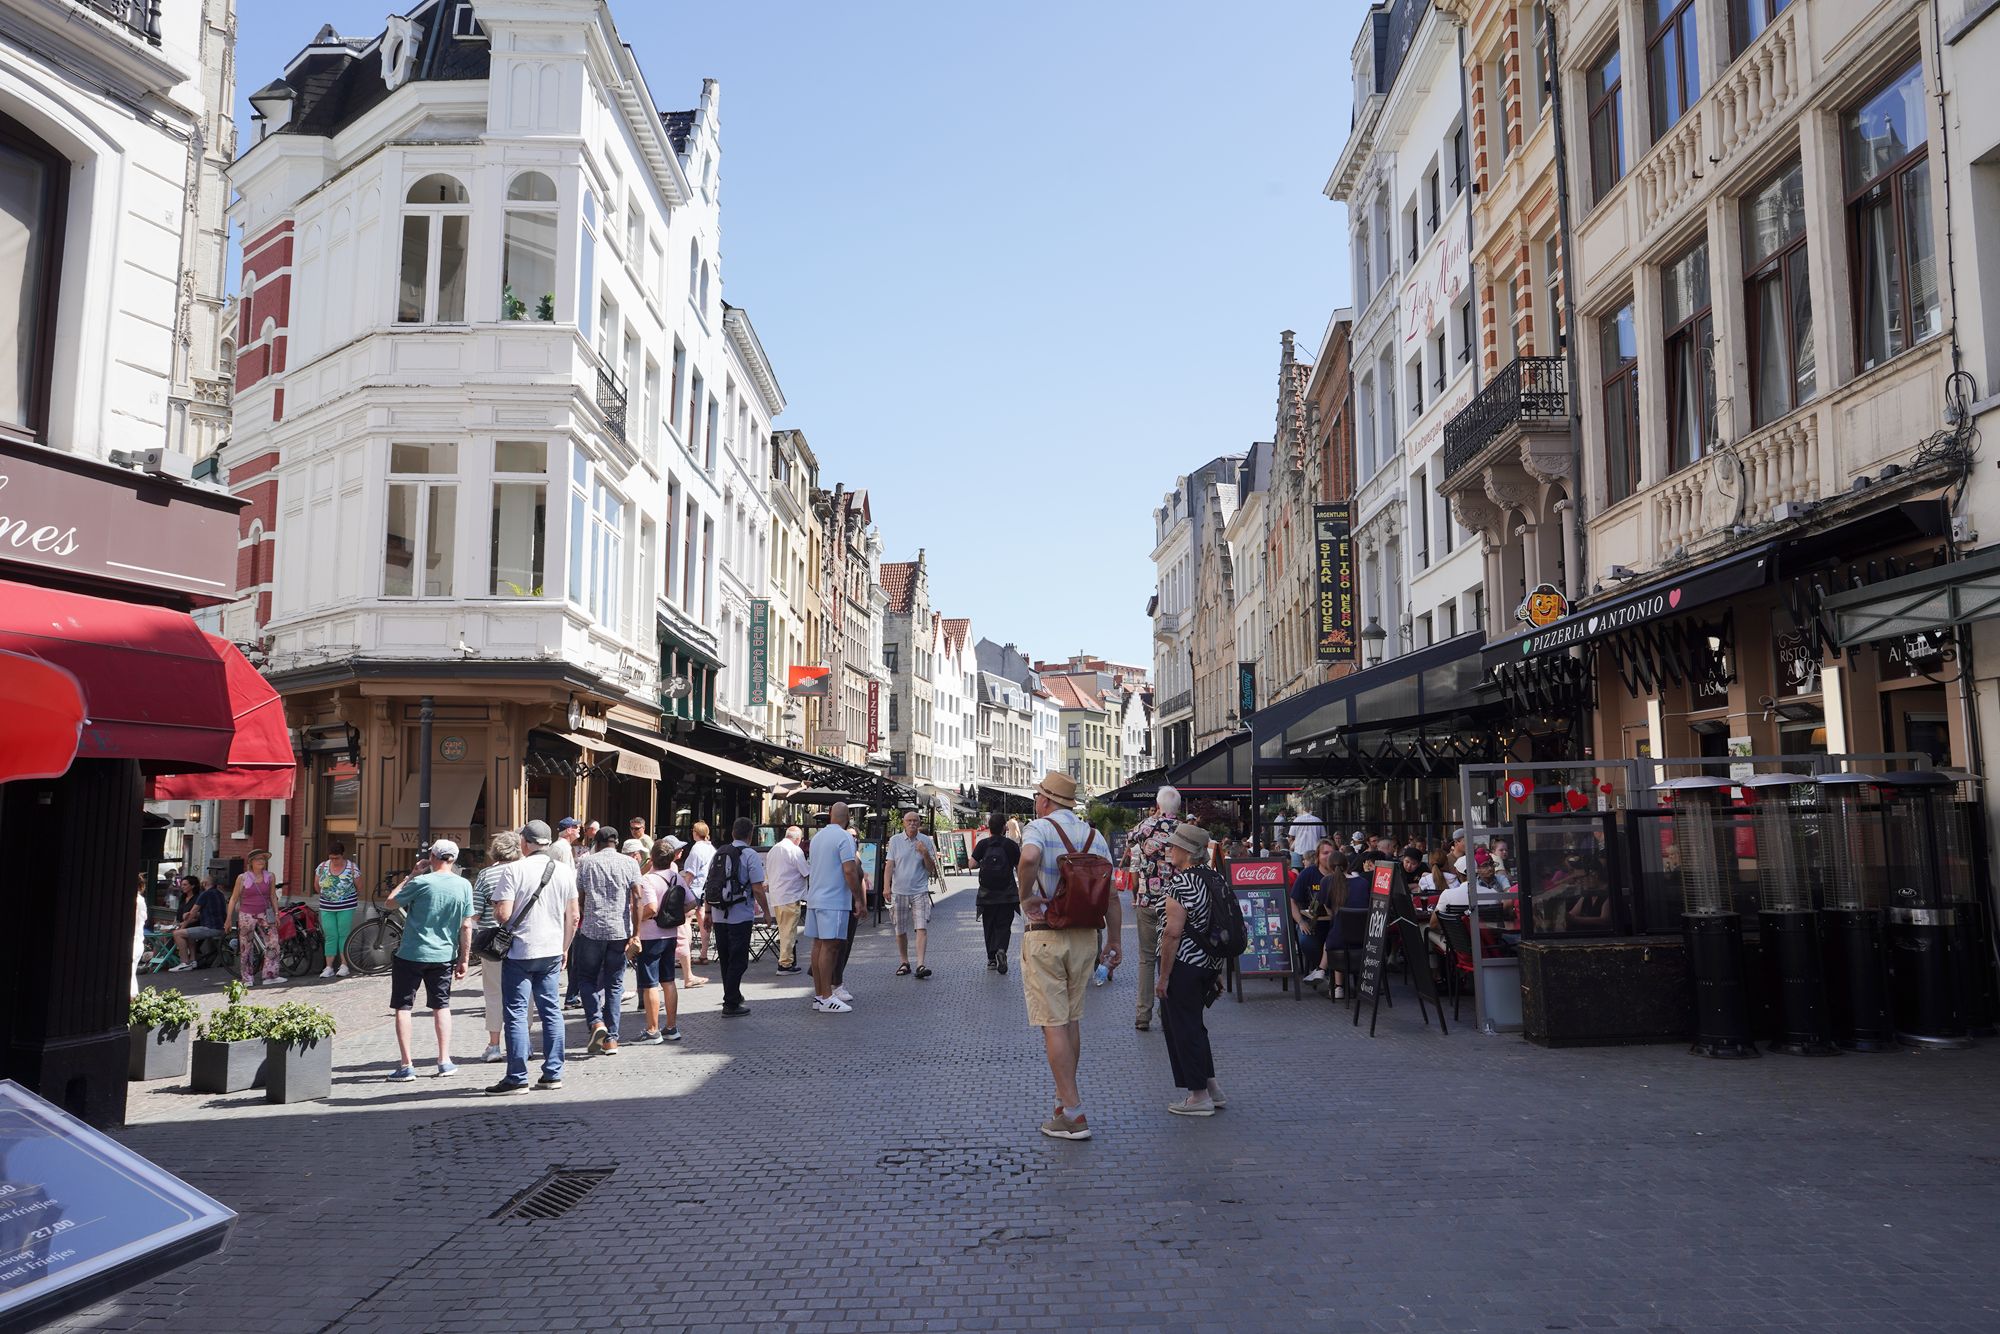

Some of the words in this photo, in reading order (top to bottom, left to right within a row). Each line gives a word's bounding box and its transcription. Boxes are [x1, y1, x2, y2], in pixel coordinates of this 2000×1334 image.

[1320, 542, 1332, 583] STEAK
[1340, 543, 1348, 557] EL
[753, 603, 765, 623] DEL
[1321, 591, 1332, 633] HOUSE
[1341, 593, 1352, 627] NEGRO
[1533, 622, 1584, 651] PIZZERIA
[1599, 595, 1663, 632] ANTONIO
[753, 626, 764, 646] SUD
[752, 649, 764, 703] CLASSICO
[869, 683, 877, 751] PIZZERIA
[1368, 910, 1387, 938] OPEN
[12, 1198, 58, 1217] frietjes
[0, 1266, 27, 1281] met
[26, 1248, 76, 1270] Frietjes
